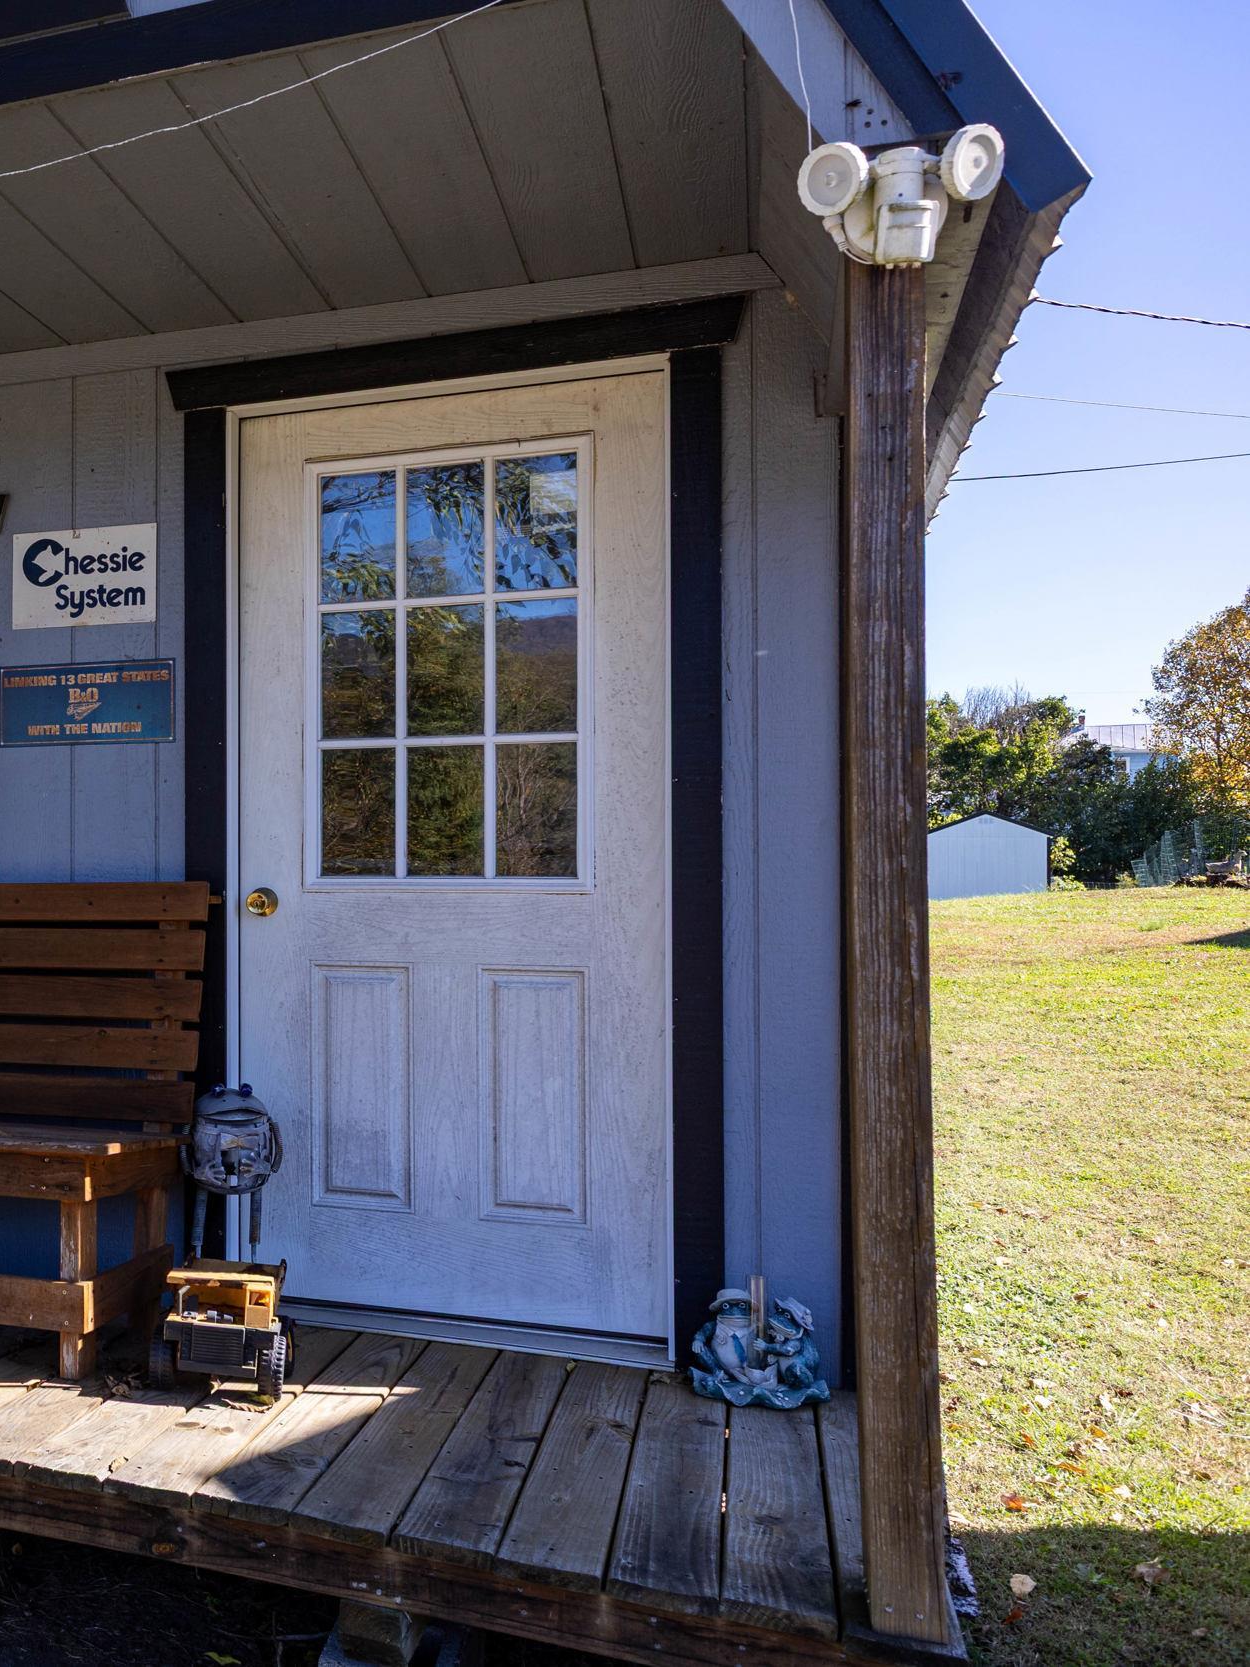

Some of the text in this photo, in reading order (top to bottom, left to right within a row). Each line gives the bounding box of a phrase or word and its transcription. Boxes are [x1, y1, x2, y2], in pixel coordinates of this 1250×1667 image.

[22, 539, 146, 587] Chessie
[55, 584, 145, 618] System
[3, 670, 169, 688] LINKING 13 GREAT STATES
[68, 688, 98, 703] B&O
[28, 722, 142, 736] WITH THE NATION
